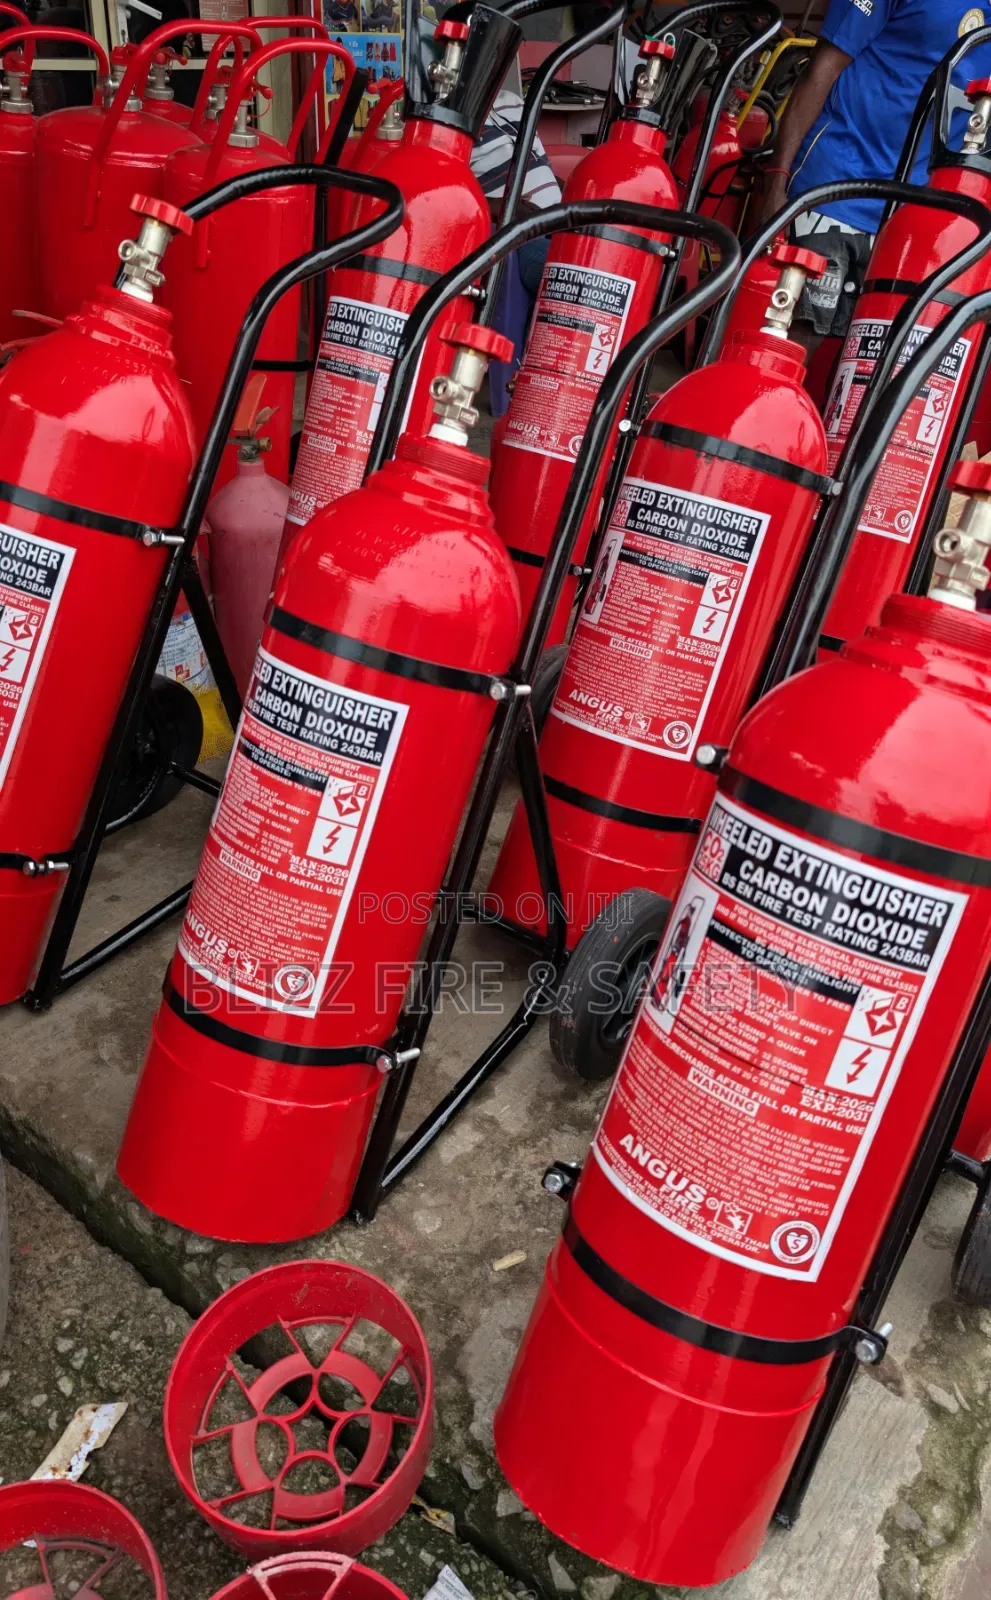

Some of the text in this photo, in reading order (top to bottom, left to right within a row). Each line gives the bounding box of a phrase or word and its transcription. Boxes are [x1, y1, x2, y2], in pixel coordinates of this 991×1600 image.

[550, 282, 621, 306] CARBON DIOXIDE
[558, 269, 628, 296] EXTINGUISHER
[579, 297, 601, 308] RATING
[327, 320, 360, 336] CARBON
[343, 335, 385, 353] TEST RATING
[657, 494, 758, 535] EXTINGUISHER
[627, 519, 750, 560] BS EN FIRE TEST RATING 243BAR
[637, 508, 688, 532] CARBON
[690, 523, 747, 549] DIOXIDE
[654, 559, 708, 577] FROM SUNLIGHT
[15, 577, 51, 596] 243BAR
[30, 615, 39, 624] B
[612, 639, 650, 656] WARNING
[627, 637, 647, 647] AFTER
[648, 644, 663, 652] FULL
[677, 652, 702, 663] PARTIAL
[3, 700, 17, 709] USE
[271, 670, 392, 730] EXTINGUISHER
[569, 690, 624, 718] ANGUS
[255, 686, 378, 748] CARBON DIOXIDE
[596, 711, 621, 723] FIRE
[260, 708, 276, 723] FIRE
[277, 717, 299, 734] TEST
[300, 728, 338, 749] RATING
[340, 742, 382, 762] 243BAR
[265, 754, 327, 783] FROM SUNLIGHT
[328, 765, 344, 774] FIRE
[304, 787, 321, 797] FREE
[357, 785, 368, 796] B
[221, 852, 258, 879] WARNING
[235, 851, 343, 896] AFTER FULL OR PARTIAL USE
[289, 864, 344, 886] EXP:2031
[290, 855, 350, 878] MAN:2026
[774, 844, 947, 927] EXTINGUISHER
[740, 860, 928, 950] CARBON DIOXIDE
[186, 912, 228, 951] ANGUS
[722, 872, 930, 967] BS EN FIRE TEST RATING 243BAR
[201, 942, 225, 962] FIRE
[710, 919, 798, 971] PROTECTION FROM
[742, 947, 753, 958] TO
[795, 946, 817, 959] RISK
[818, 955, 860, 976] GASEOUS
[862, 972, 882, 983] FIRE
[883, 978, 918, 993] CLASSES
[852, 958, 902, 979] EQUIPMENT
[760, 993, 788, 1010] FULLY
[760, 1009, 779, 1021] FIRE
[813, 993, 850, 1012] TO FREE
[896, 997, 909, 1010] B
[744, 1009, 817, 1045] DOWN VALVE ON
[758, 1001, 833, 1035] BY LOOP DIRECT
[726, 1023, 758, 1043] ACTION
[739, 1022, 766, 1039] USING
[776, 1040, 806, 1056] QUICK
[772, 1056, 808, 1075] SECONDS
[692, 1071, 754, 1112] WARNING
[716, 1074, 866, 1138] AFTER FULL OR PARTIAL USE
[800, 1095, 868, 1122] EXP:2031
[620, 1134, 707, 1203] ANGUS
[659, 1184, 701, 1214] FIRE
[692, 1211, 705, 1223] NO
[707, 1221, 743, 1240] CLOSED
[742, 1237, 770, 1250] THAN
